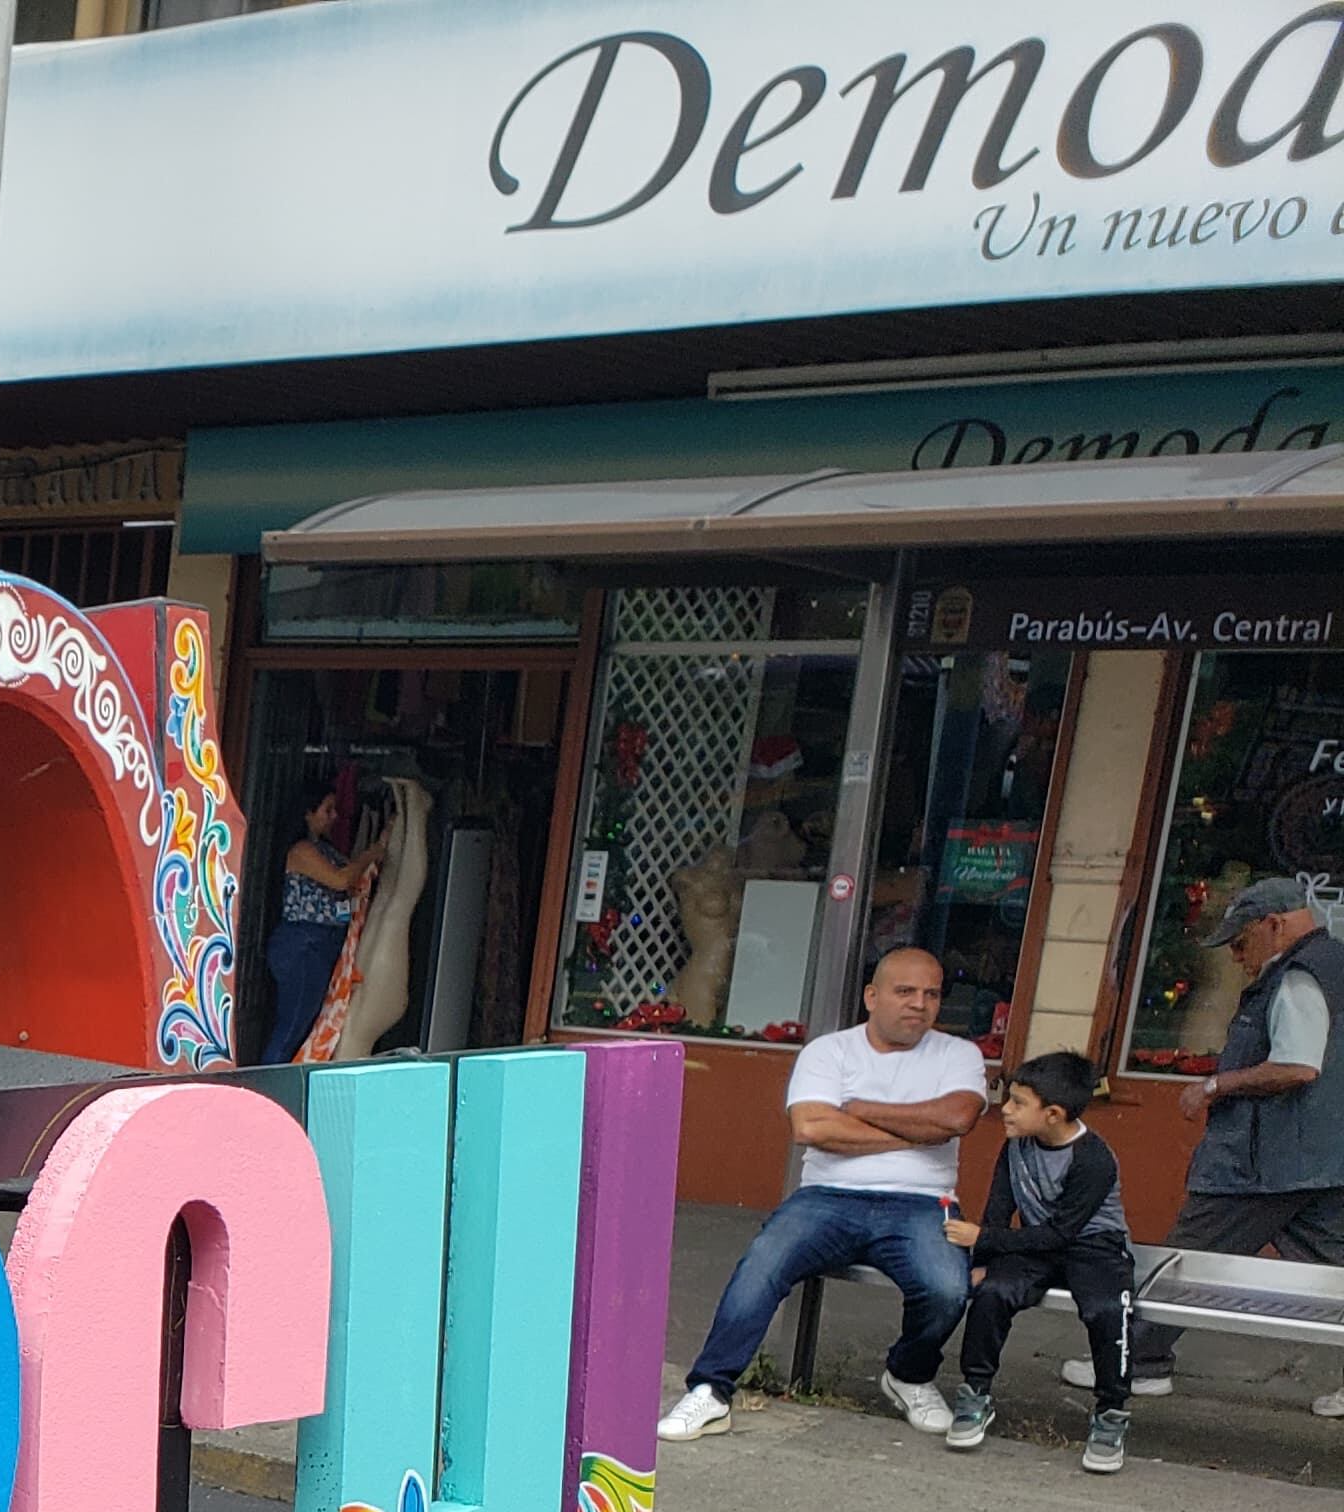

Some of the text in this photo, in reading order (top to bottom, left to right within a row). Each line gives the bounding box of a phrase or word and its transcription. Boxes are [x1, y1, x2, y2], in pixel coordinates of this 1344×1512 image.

[973, 192, 1077, 261] Un
[1101, 196, 1308, 251] nuevo
[1213, 611, 1333, 642] Central
